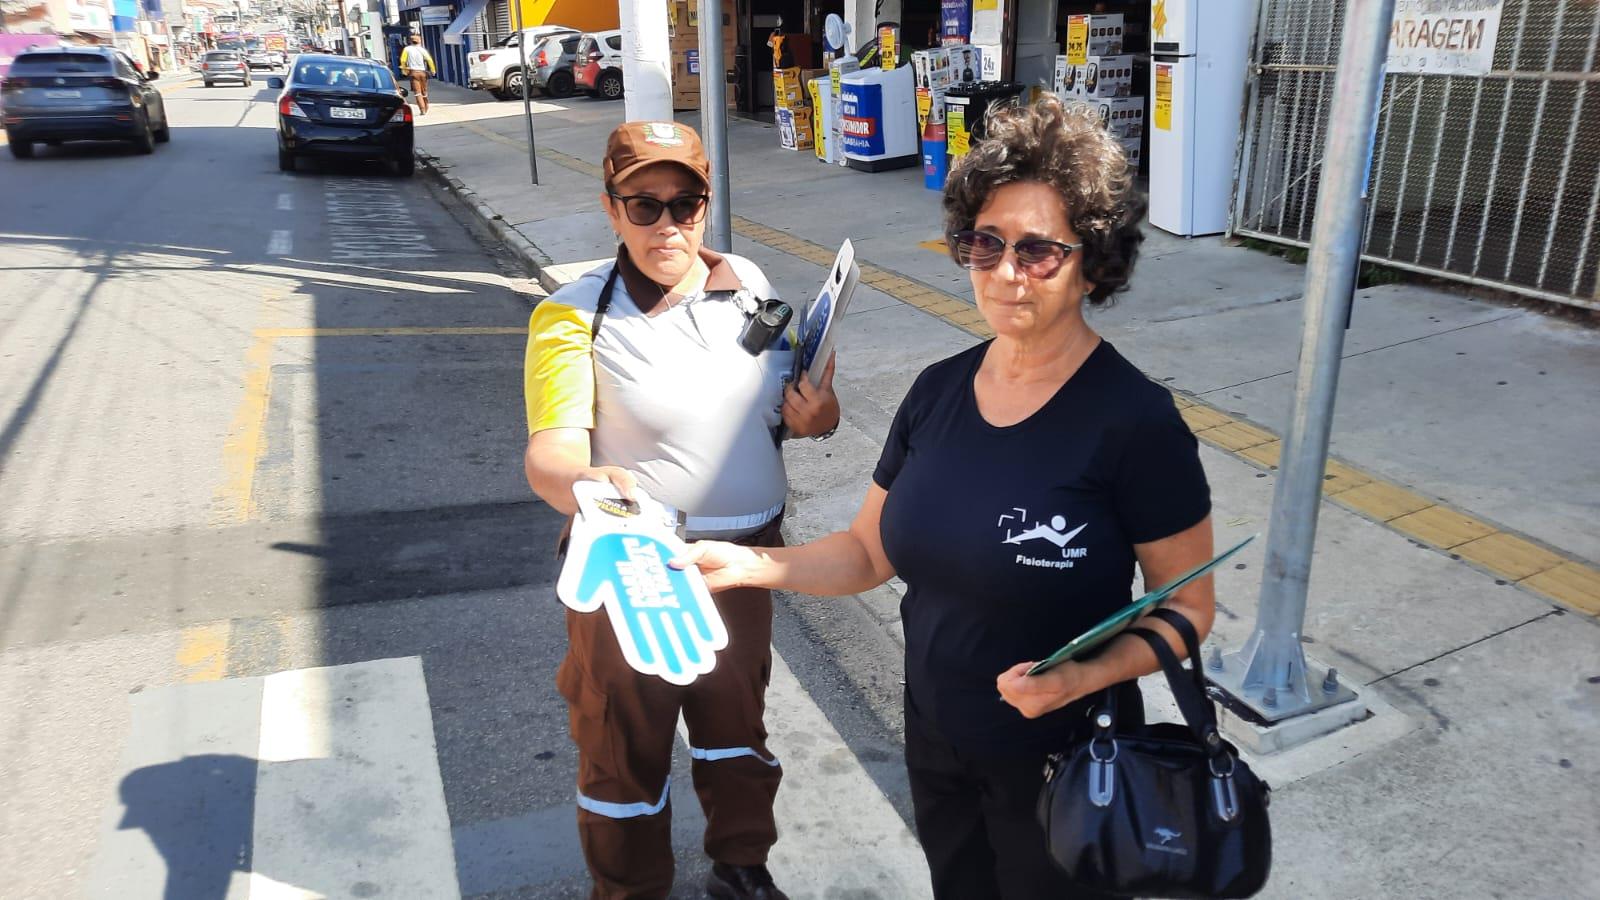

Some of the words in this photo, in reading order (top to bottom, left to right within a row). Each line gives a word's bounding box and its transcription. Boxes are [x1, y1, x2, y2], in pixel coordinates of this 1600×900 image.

[1391, 18, 1486, 50] ARAGEM
[1062, 548, 1088, 558] UMR
[1016, 555, 1074, 569] Fisioterapia
